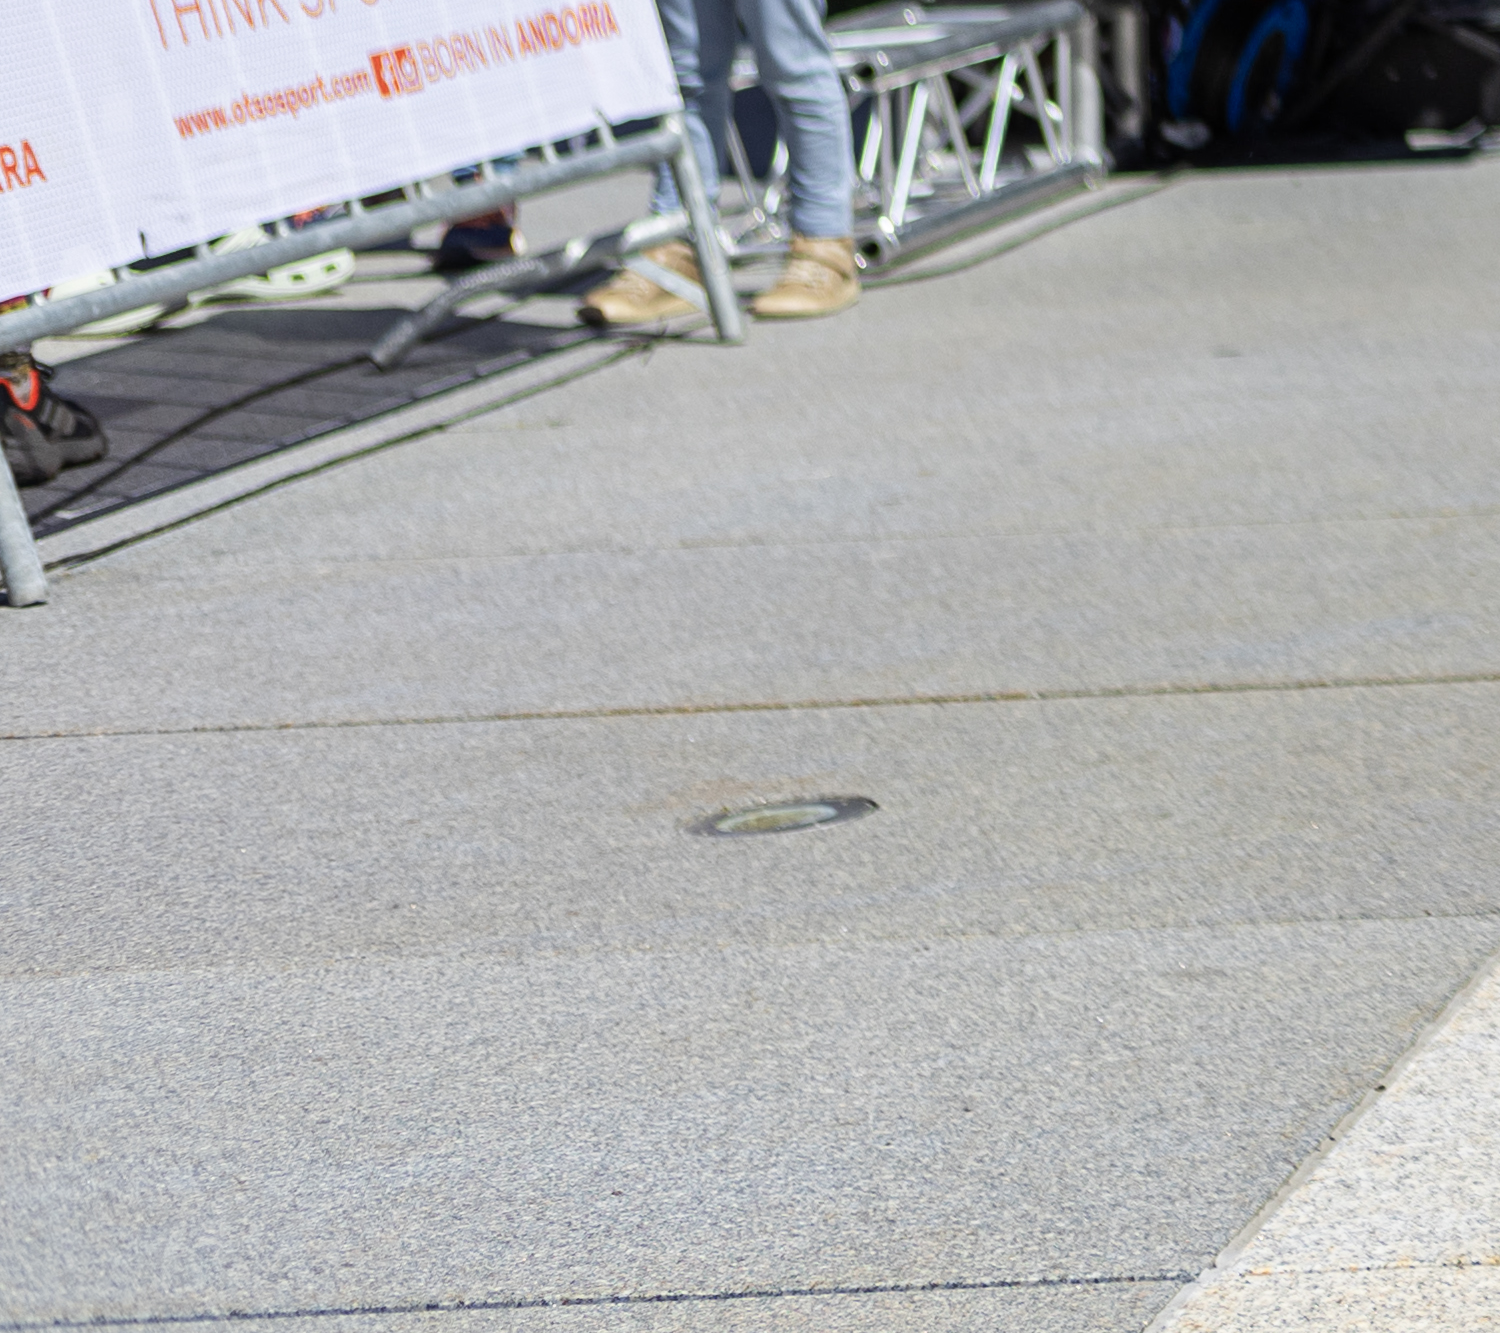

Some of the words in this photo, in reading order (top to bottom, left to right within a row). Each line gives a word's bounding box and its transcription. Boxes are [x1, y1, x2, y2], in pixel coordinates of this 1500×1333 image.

[173, 67, 373, 139] www.otsosport.com
[415, 33, 489, 83] BORN
[487, 25, 514, 65] IN
[515, 0, 622, 58] ANDORRA
